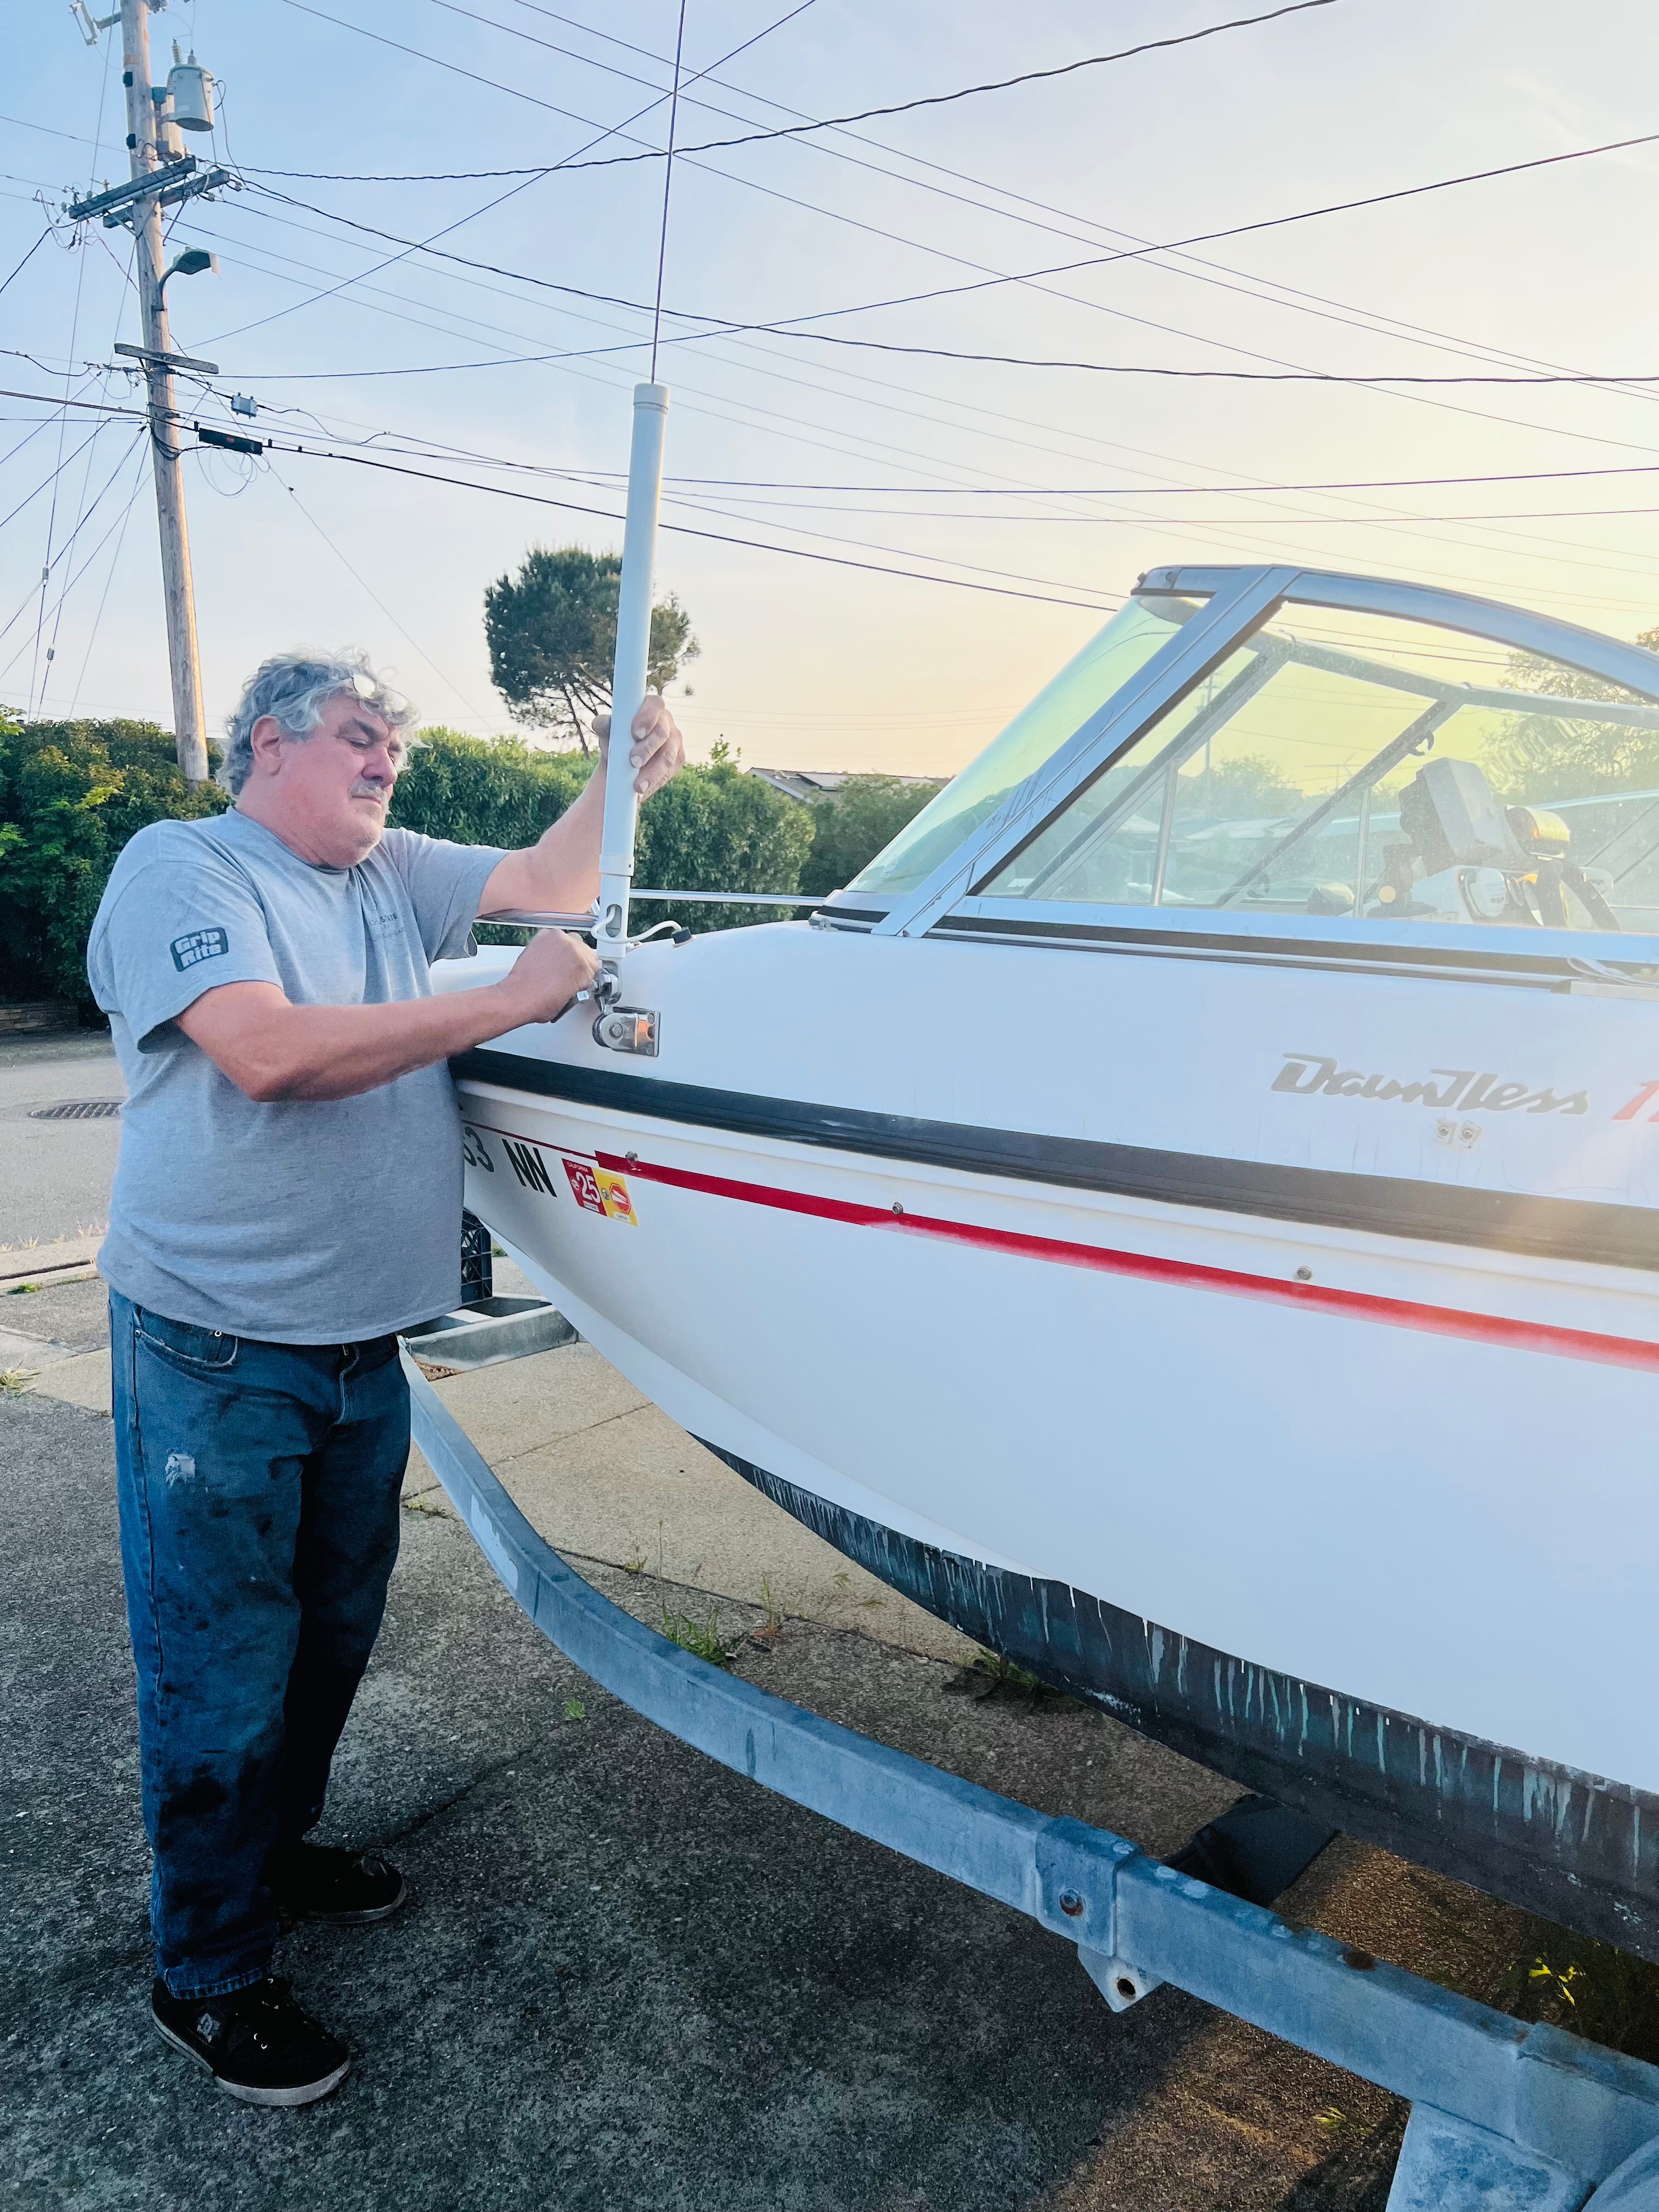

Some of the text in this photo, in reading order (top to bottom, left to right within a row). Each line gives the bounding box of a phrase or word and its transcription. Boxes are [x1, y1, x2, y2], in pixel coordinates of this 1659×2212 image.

[174, 931, 221, 954] Grip
[180, 944, 222, 968] Rite
[1271, 1053, 1659, 1122] Dauntless 1
[501, 1138, 558, 1198] NN
[575, 1171, 601, 1204] 25
